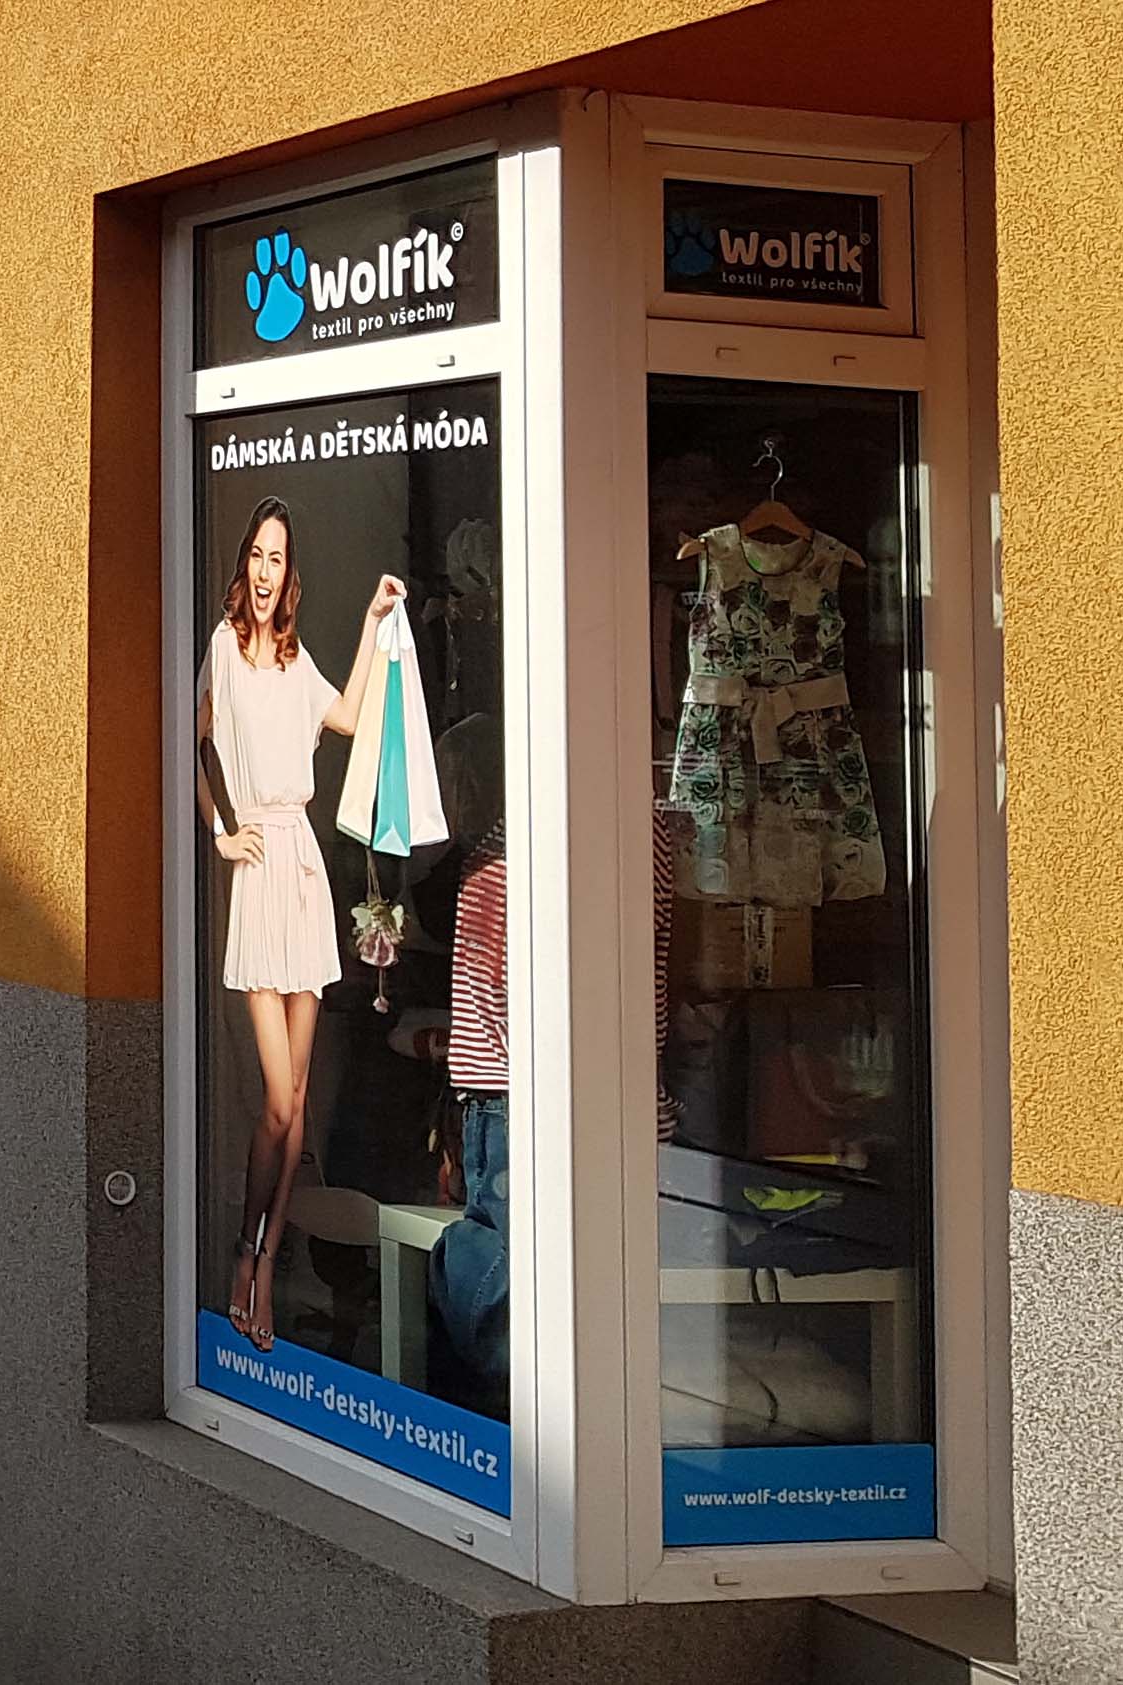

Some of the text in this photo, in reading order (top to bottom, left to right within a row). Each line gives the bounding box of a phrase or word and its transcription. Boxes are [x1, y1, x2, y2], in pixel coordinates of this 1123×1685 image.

[310, 228, 454, 311] Wolfík
[719, 229, 862, 273] Wolfík
[722, 271, 863, 296] textil pro všechny
[312, 302, 455, 340] textil pro všechny
[211, 410, 488, 471] DÁMSKÁ A DĚTSKÁ MÓDA
[216, 1346, 498, 1477] www.wolf-detsky-textil.cz
[684, 1485, 908, 1506] www.wolf-detsky-textil.cz
